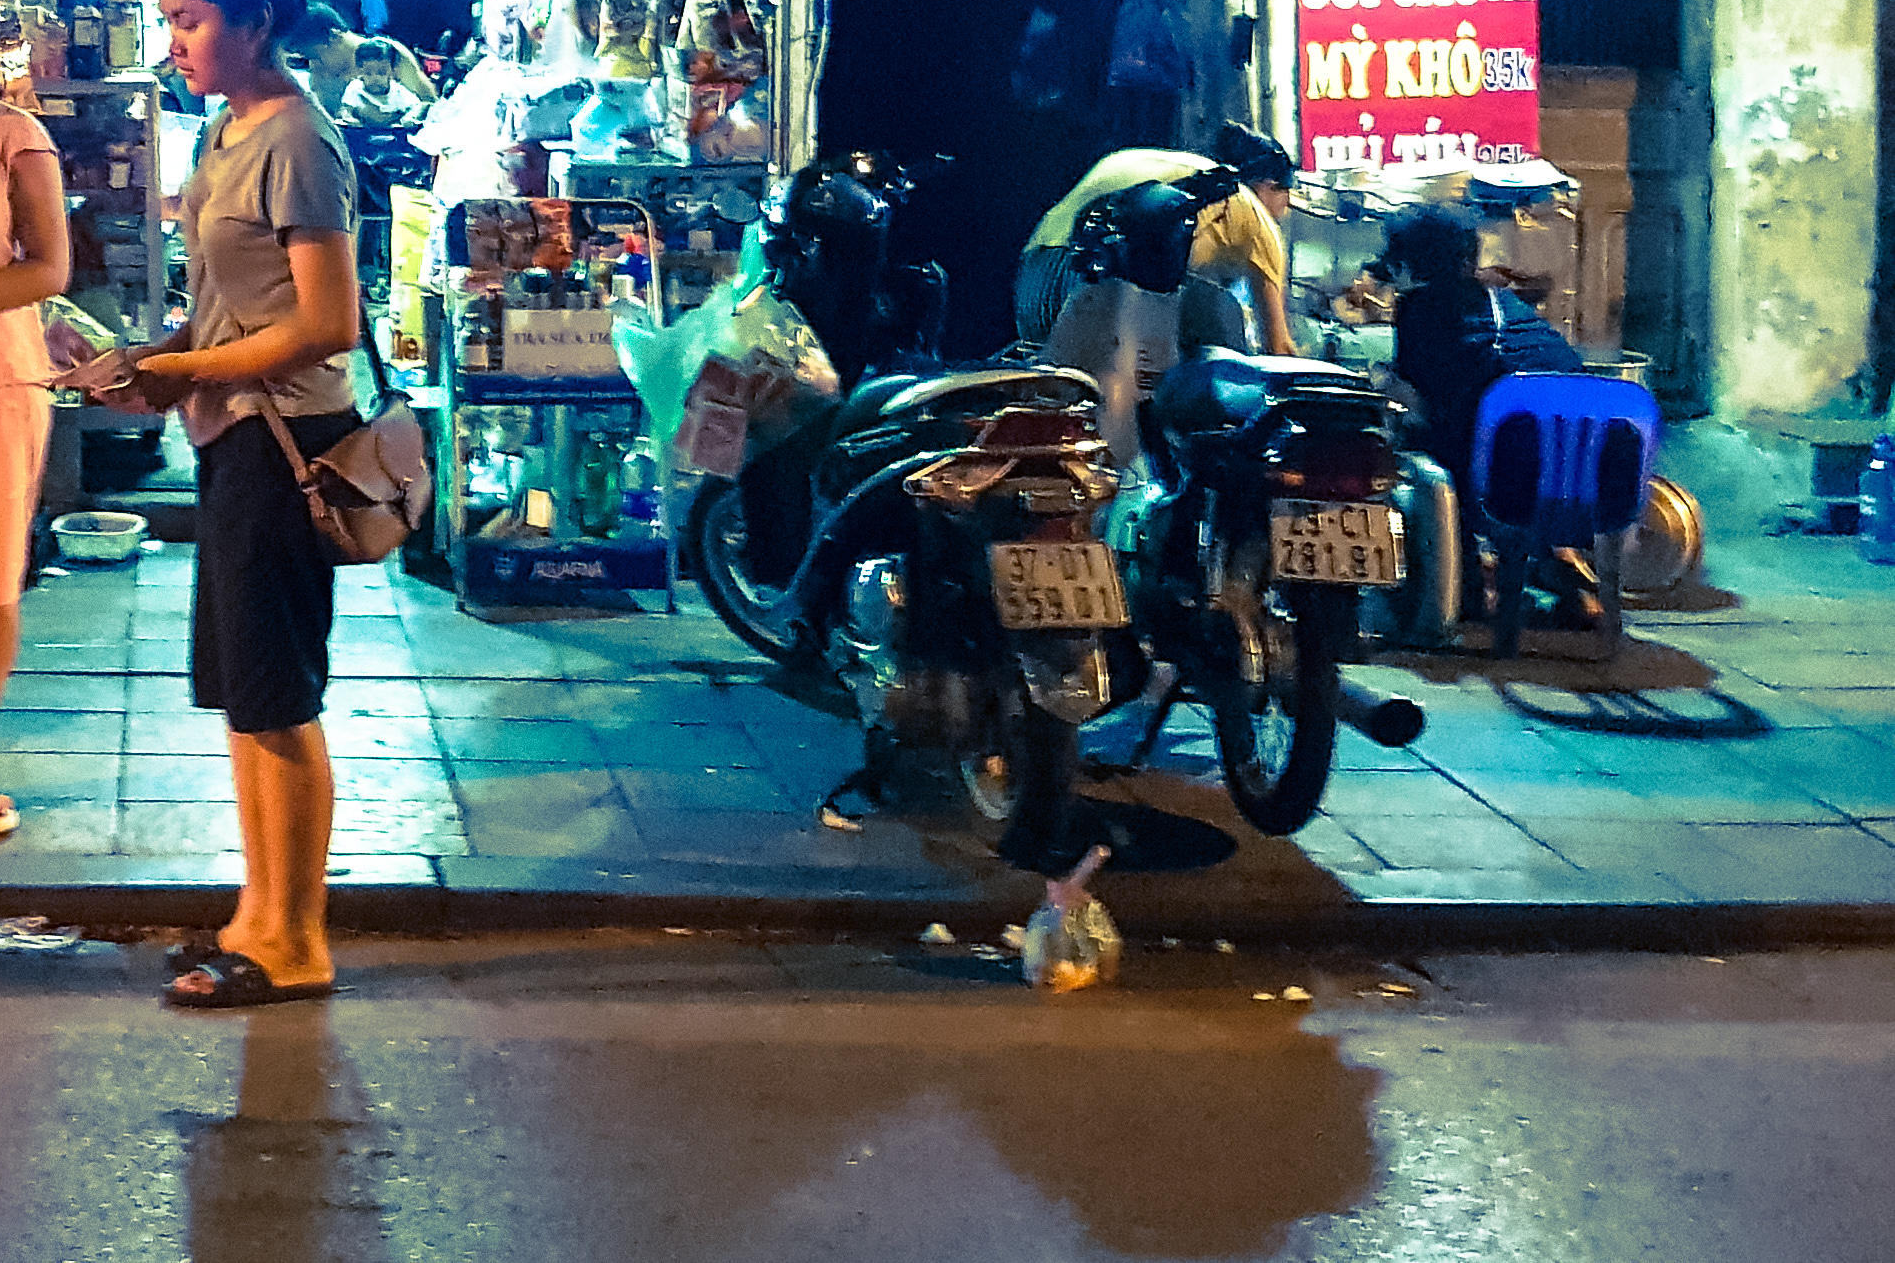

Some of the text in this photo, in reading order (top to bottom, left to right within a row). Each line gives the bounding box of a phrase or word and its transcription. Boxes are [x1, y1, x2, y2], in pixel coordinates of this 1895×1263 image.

[1305, 20, 1536, 100] MỲ KHÔ 35k
